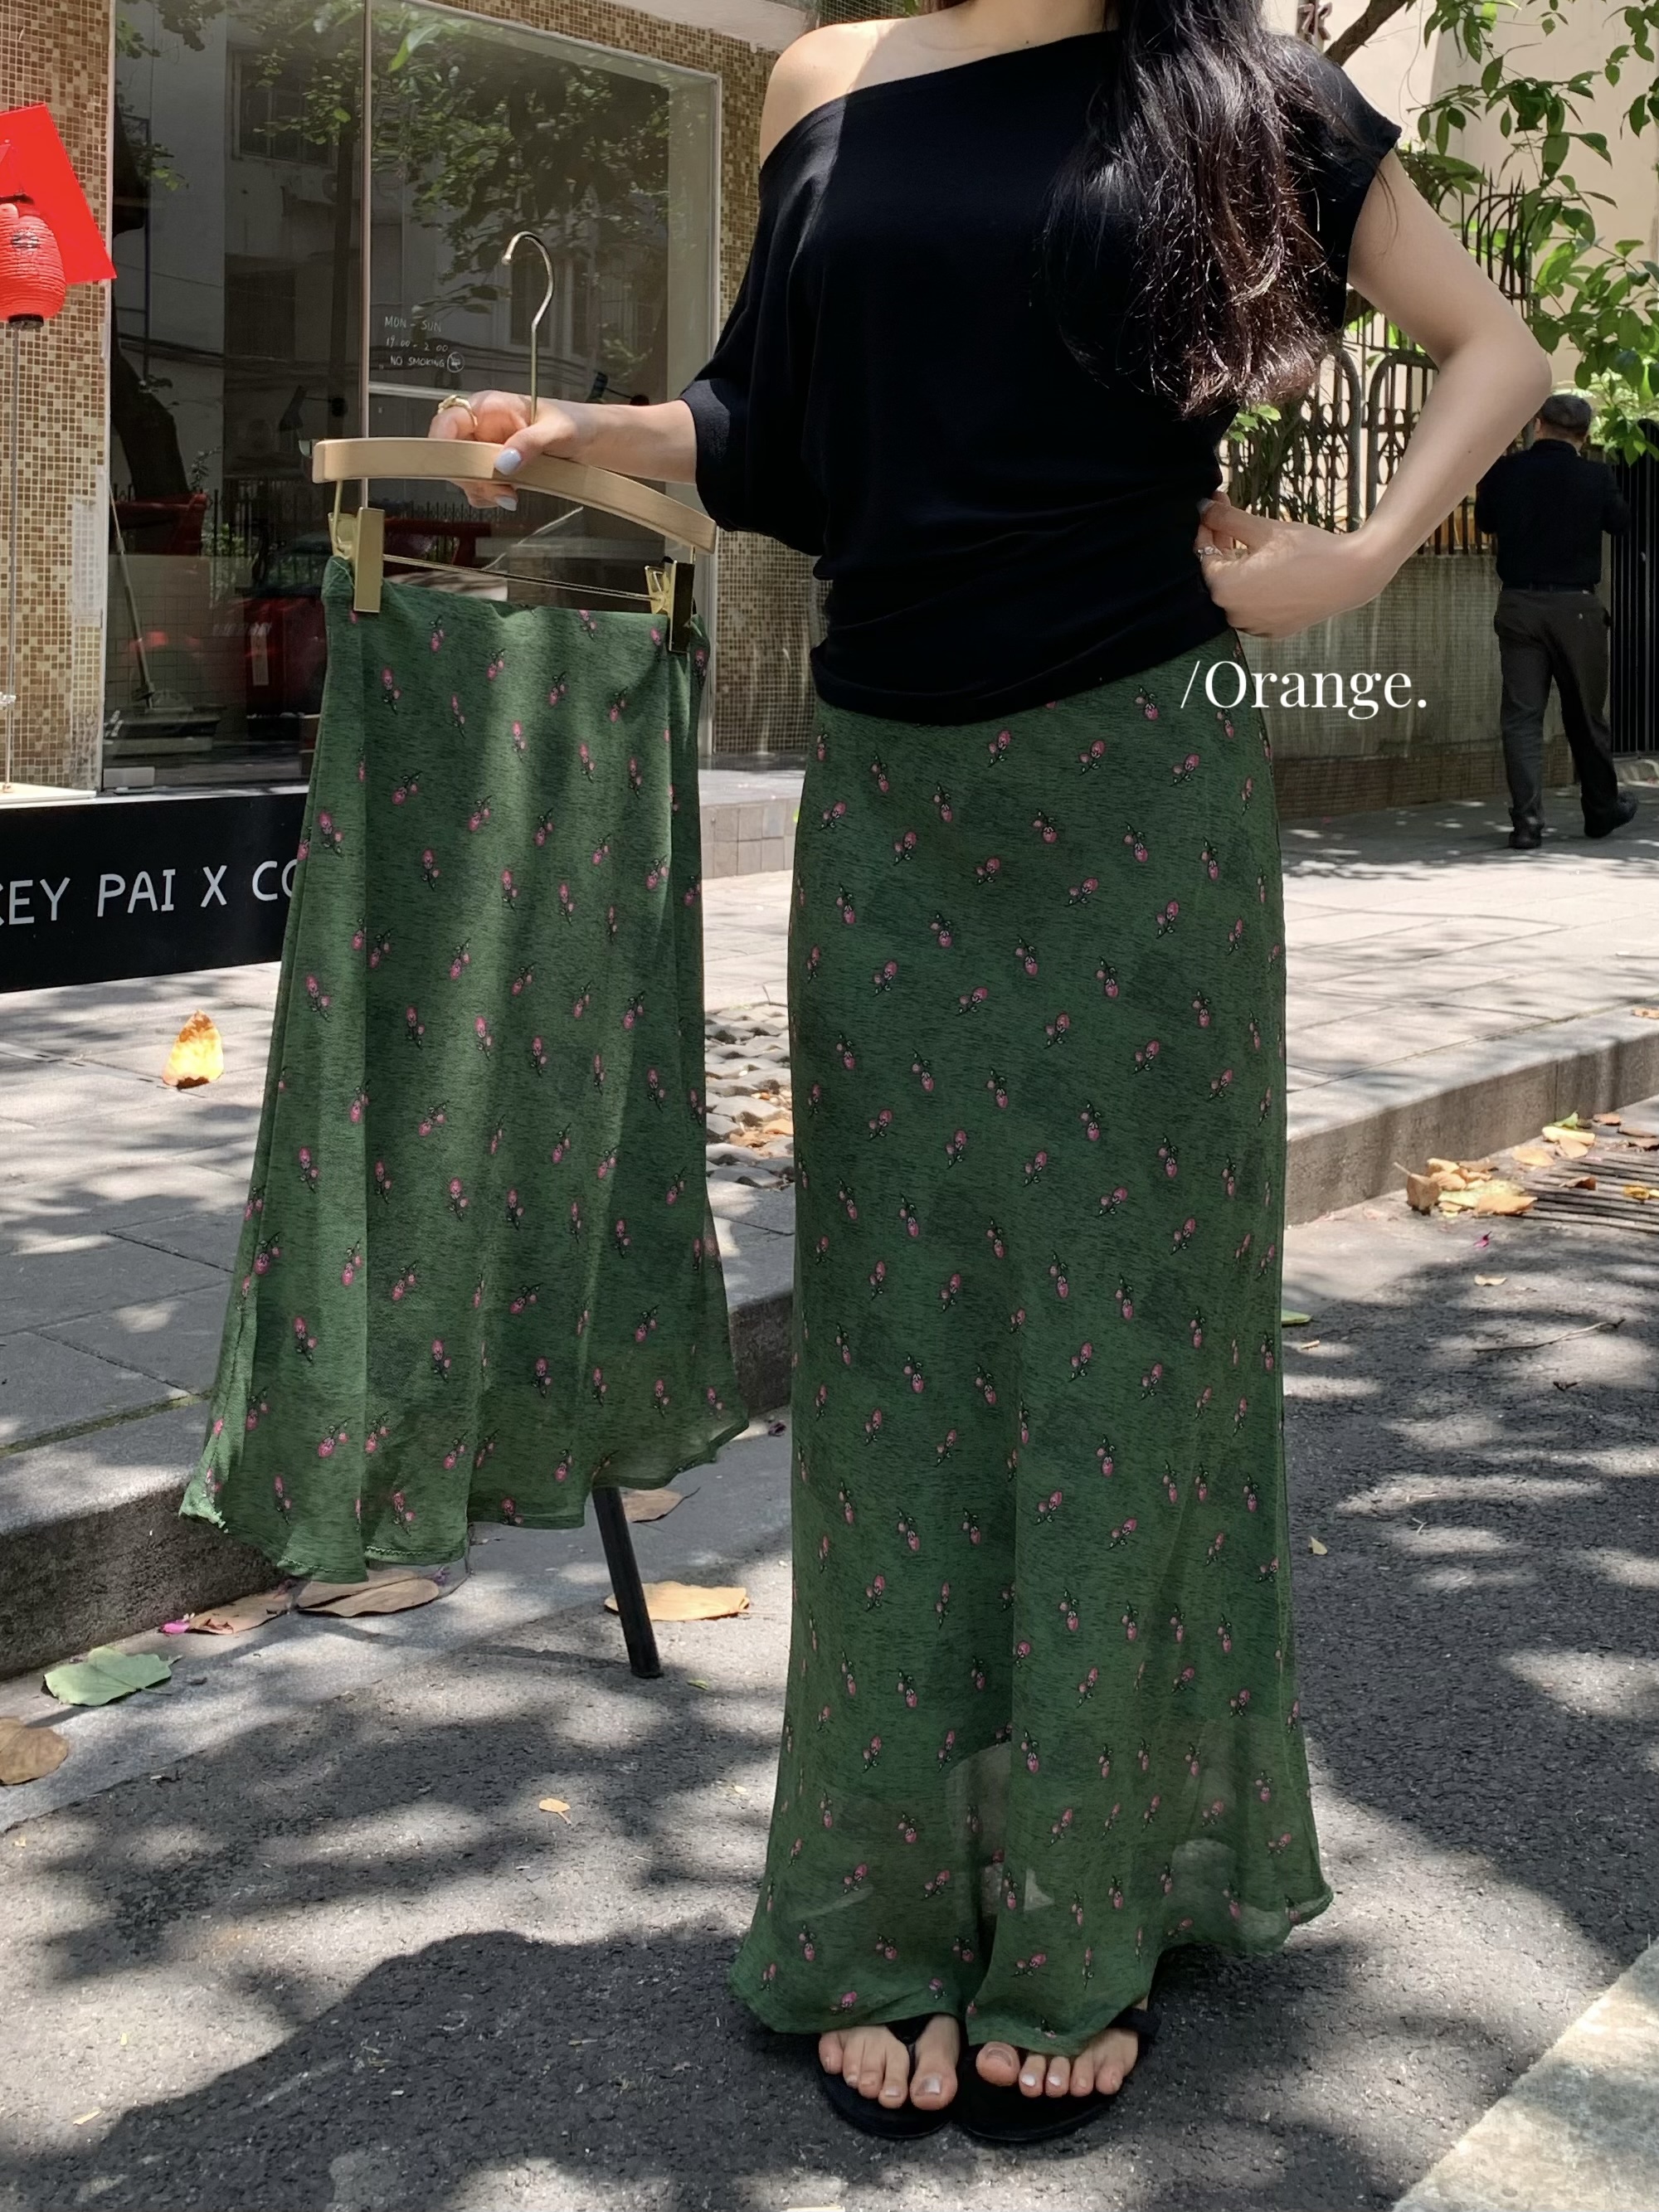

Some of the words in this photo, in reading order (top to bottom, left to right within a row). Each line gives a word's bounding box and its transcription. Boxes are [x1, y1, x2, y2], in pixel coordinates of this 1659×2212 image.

[384, 315, 406, 328] MON
[421, 319, 442, 332] SUN
[390, 355, 403, 366] NO
[407, 357, 445, 367] SMOKING
[0, 877, 71, 925] EY
[97, 868, 176, 917] PAI
[200, 865, 227, 907] X
